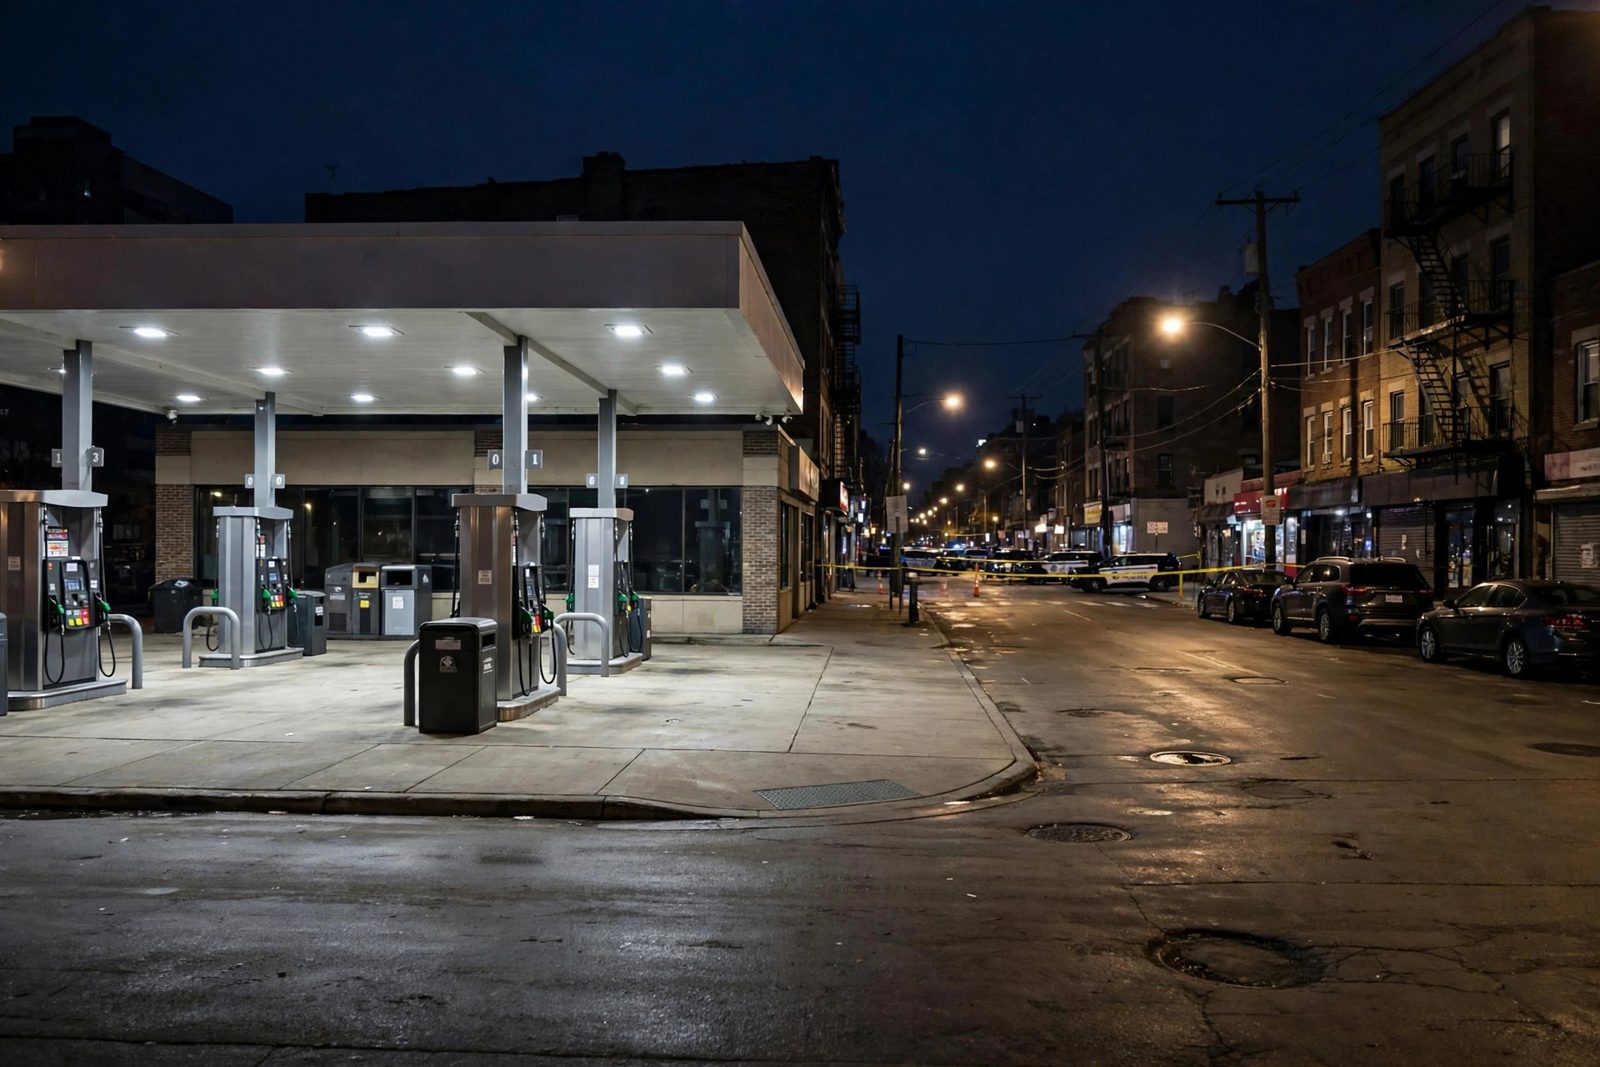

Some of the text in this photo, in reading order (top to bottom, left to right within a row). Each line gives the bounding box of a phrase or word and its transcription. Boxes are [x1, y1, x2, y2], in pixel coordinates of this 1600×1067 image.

[55, 453, 62, 464] 1
[92, 452, 99, 463] 3
[532, 453, 538, 465] 1
